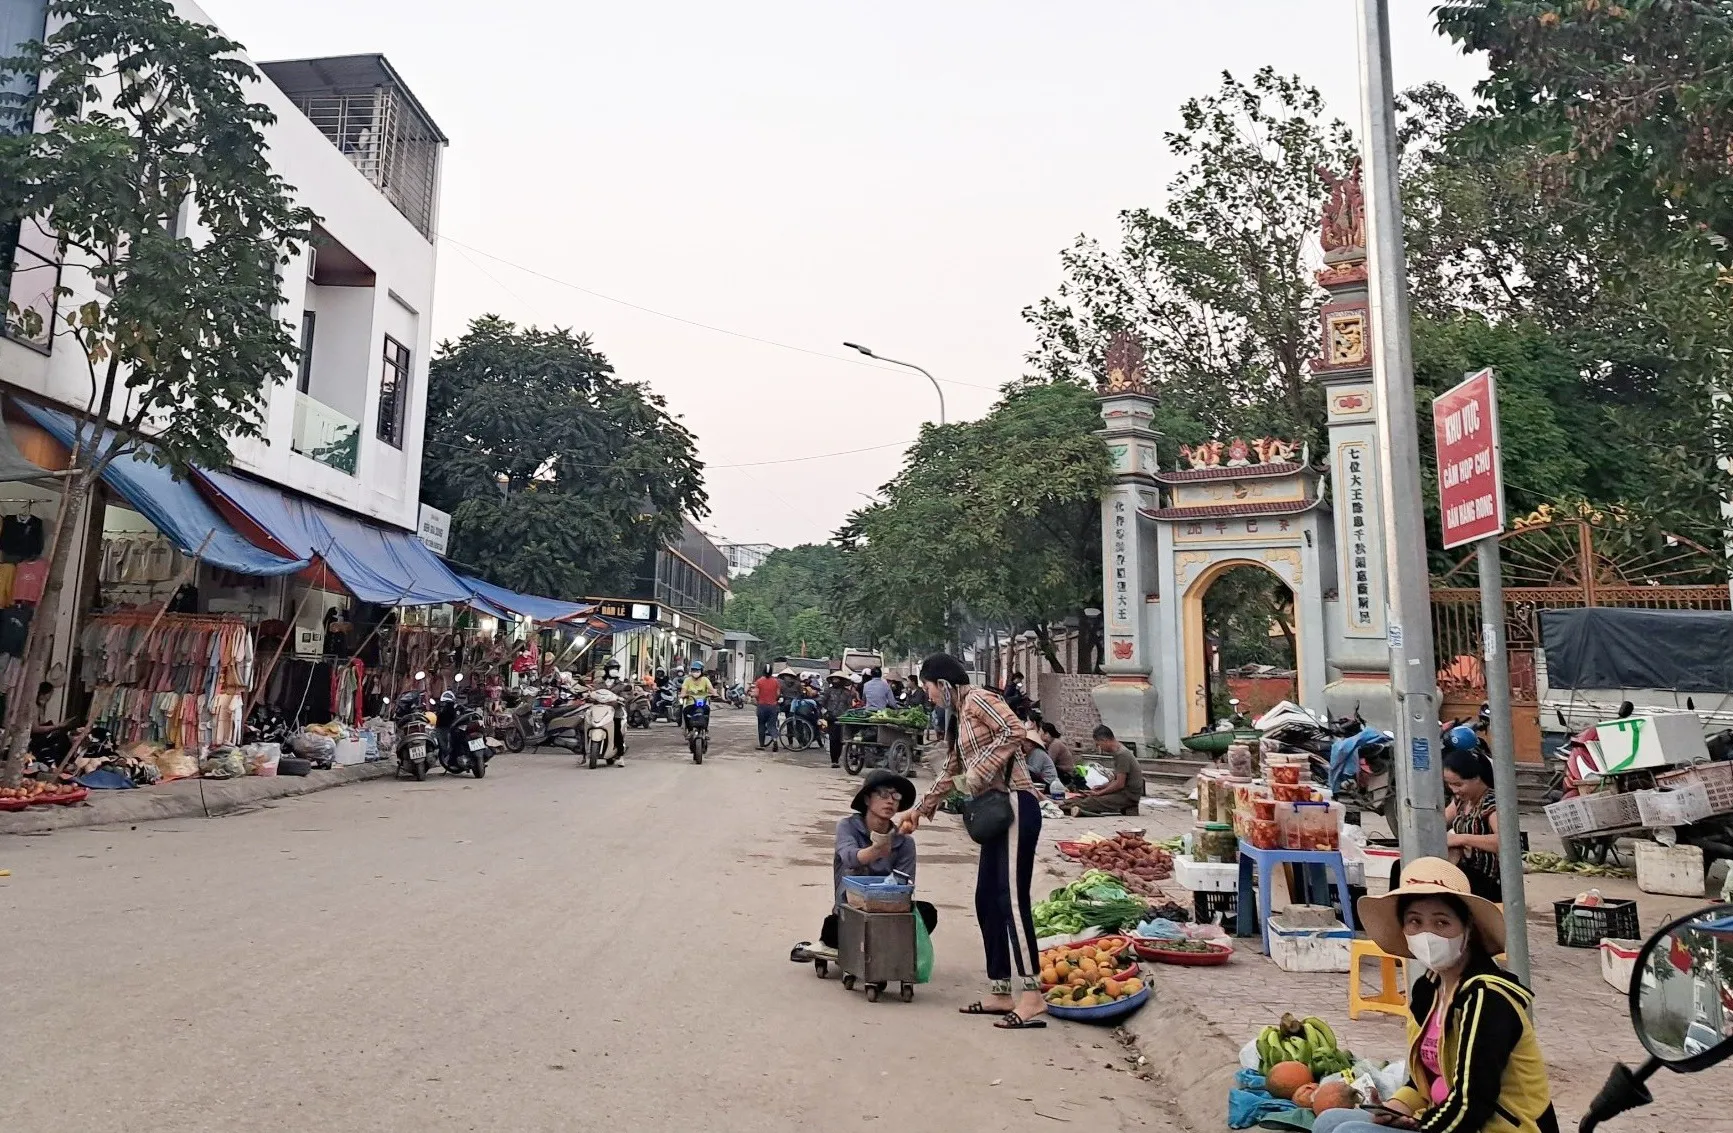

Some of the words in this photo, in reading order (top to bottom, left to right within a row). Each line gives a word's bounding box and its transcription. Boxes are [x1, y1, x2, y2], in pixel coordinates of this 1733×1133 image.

[1445, 410, 1462, 446] KHU
[1462, 399, 1480, 440] VỰC
[1474, 446, 1490, 476] CHỢ
